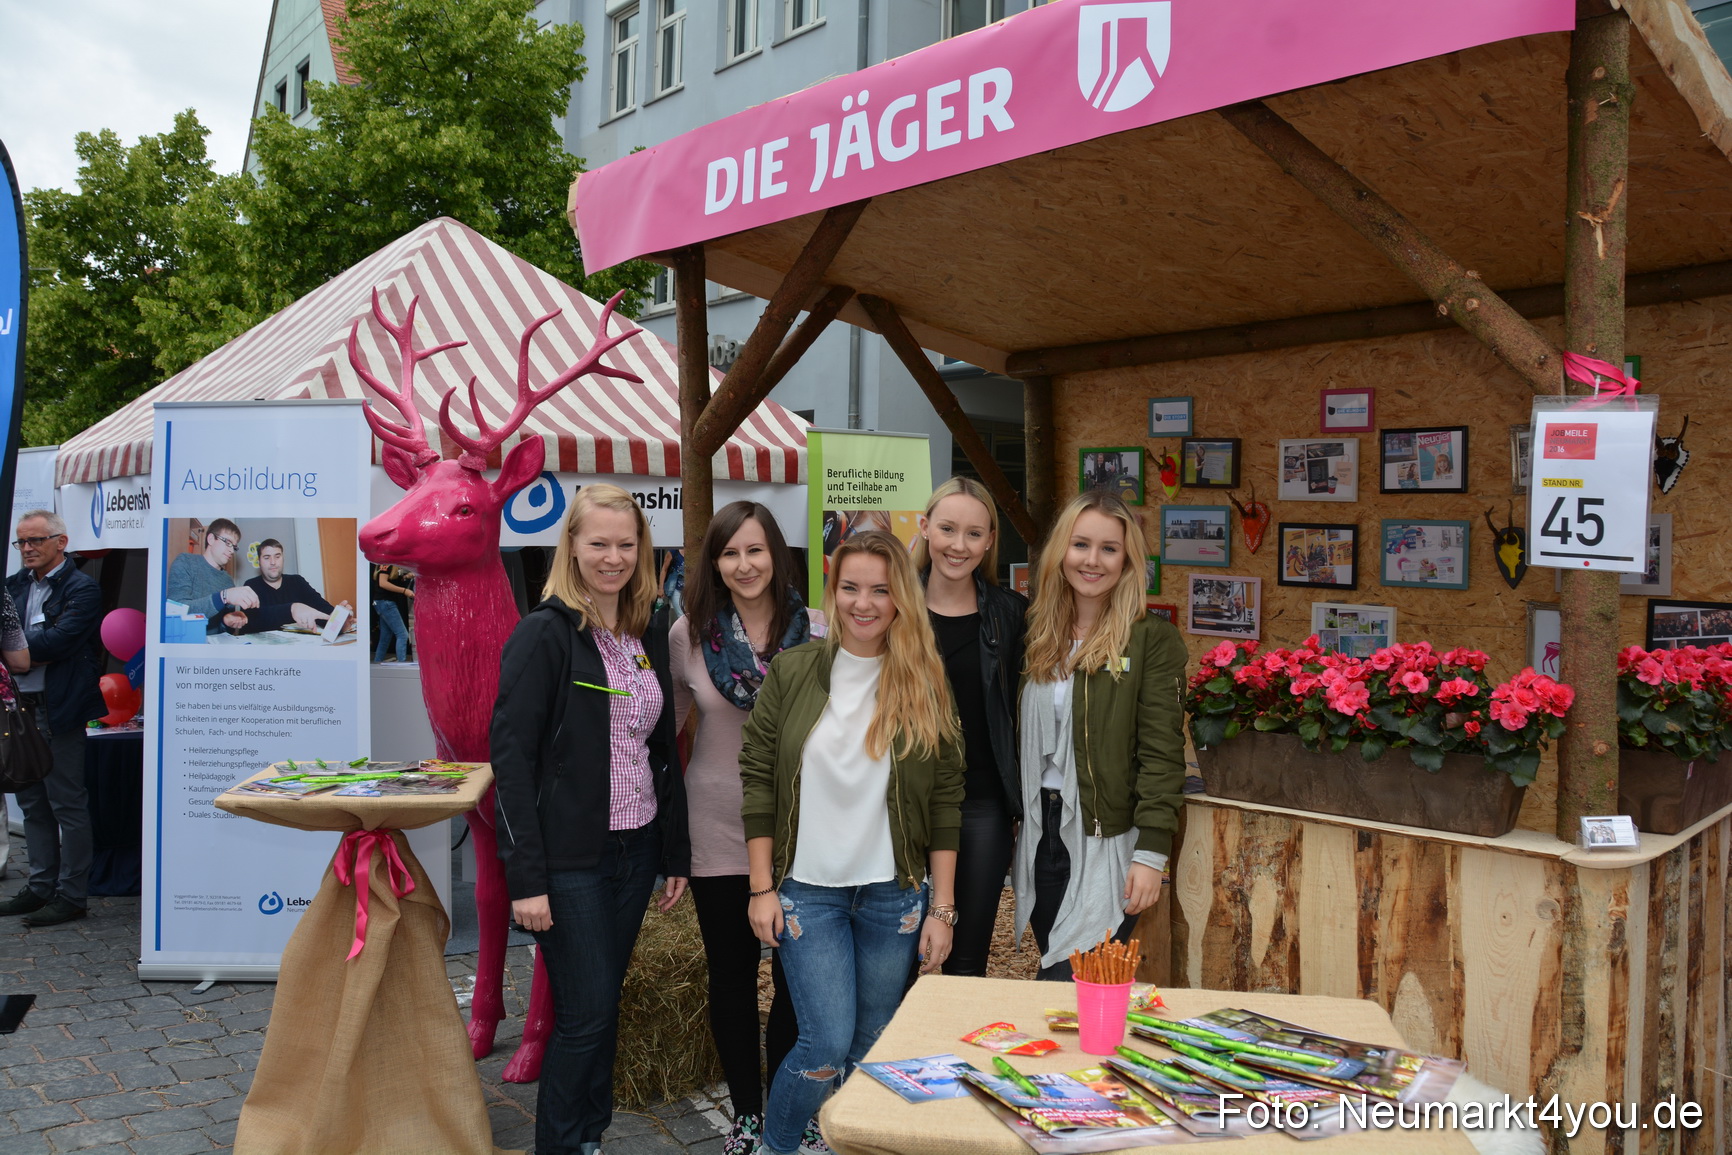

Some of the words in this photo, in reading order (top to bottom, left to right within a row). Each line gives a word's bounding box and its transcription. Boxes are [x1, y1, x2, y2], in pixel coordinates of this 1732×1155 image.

[704, 136, 789, 216] DIE
[809, 66, 1015, 193] JÄGER
[1551, 429, 1588, 437] JOBMEILE
[827, 468, 872, 478] Berufliche
[874, 469, 904, 482] Bildung
[181, 466, 318, 497] Ausbildung
[827, 482, 844, 491] und
[847, 482, 882, 491] Teilhabe
[884, 484, 897, 492] am
[827, 495, 882, 504] Arbeitsleben
[1541, 496, 1604, 546] 45
[176, 666, 190, 675] Wir
[193, 666, 220, 675] bilden
[222, 668, 252, 676] unsere
[255, 667, 301, 677] Fachkräfte
[176, 682, 192, 690] von
[194, 683, 228, 692] morgen
[230, 682, 256, 691] selbst
[175, 702, 186, 710] Sie
[187, 702, 211, 710] haben
[211, 703, 222, 711] bei
[238, 703, 271, 713] vielfältige
[273, 704, 336, 714] Ausbildungsmög-
[175, 715, 210, 723] lichkeiten
[218, 717, 240, 725] enger
[241, 716, 285, 726] Kooperation
[286, 717, 299, 725] mit
[300, 718, 342, 726] beruflichen
[175, 727, 205, 736] Schulen,
[208, 728, 227, 736] Fach-
[244, 729, 293, 738] Hochschulen:
[188, 747, 259, 757] Heilerziehungspflege
[188, 772, 236, 783] Heilpädagogik
[188, 798, 214, 806] Gesund
[188, 811, 211, 819] Duales
[287, 897, 312, 906] Lebe
